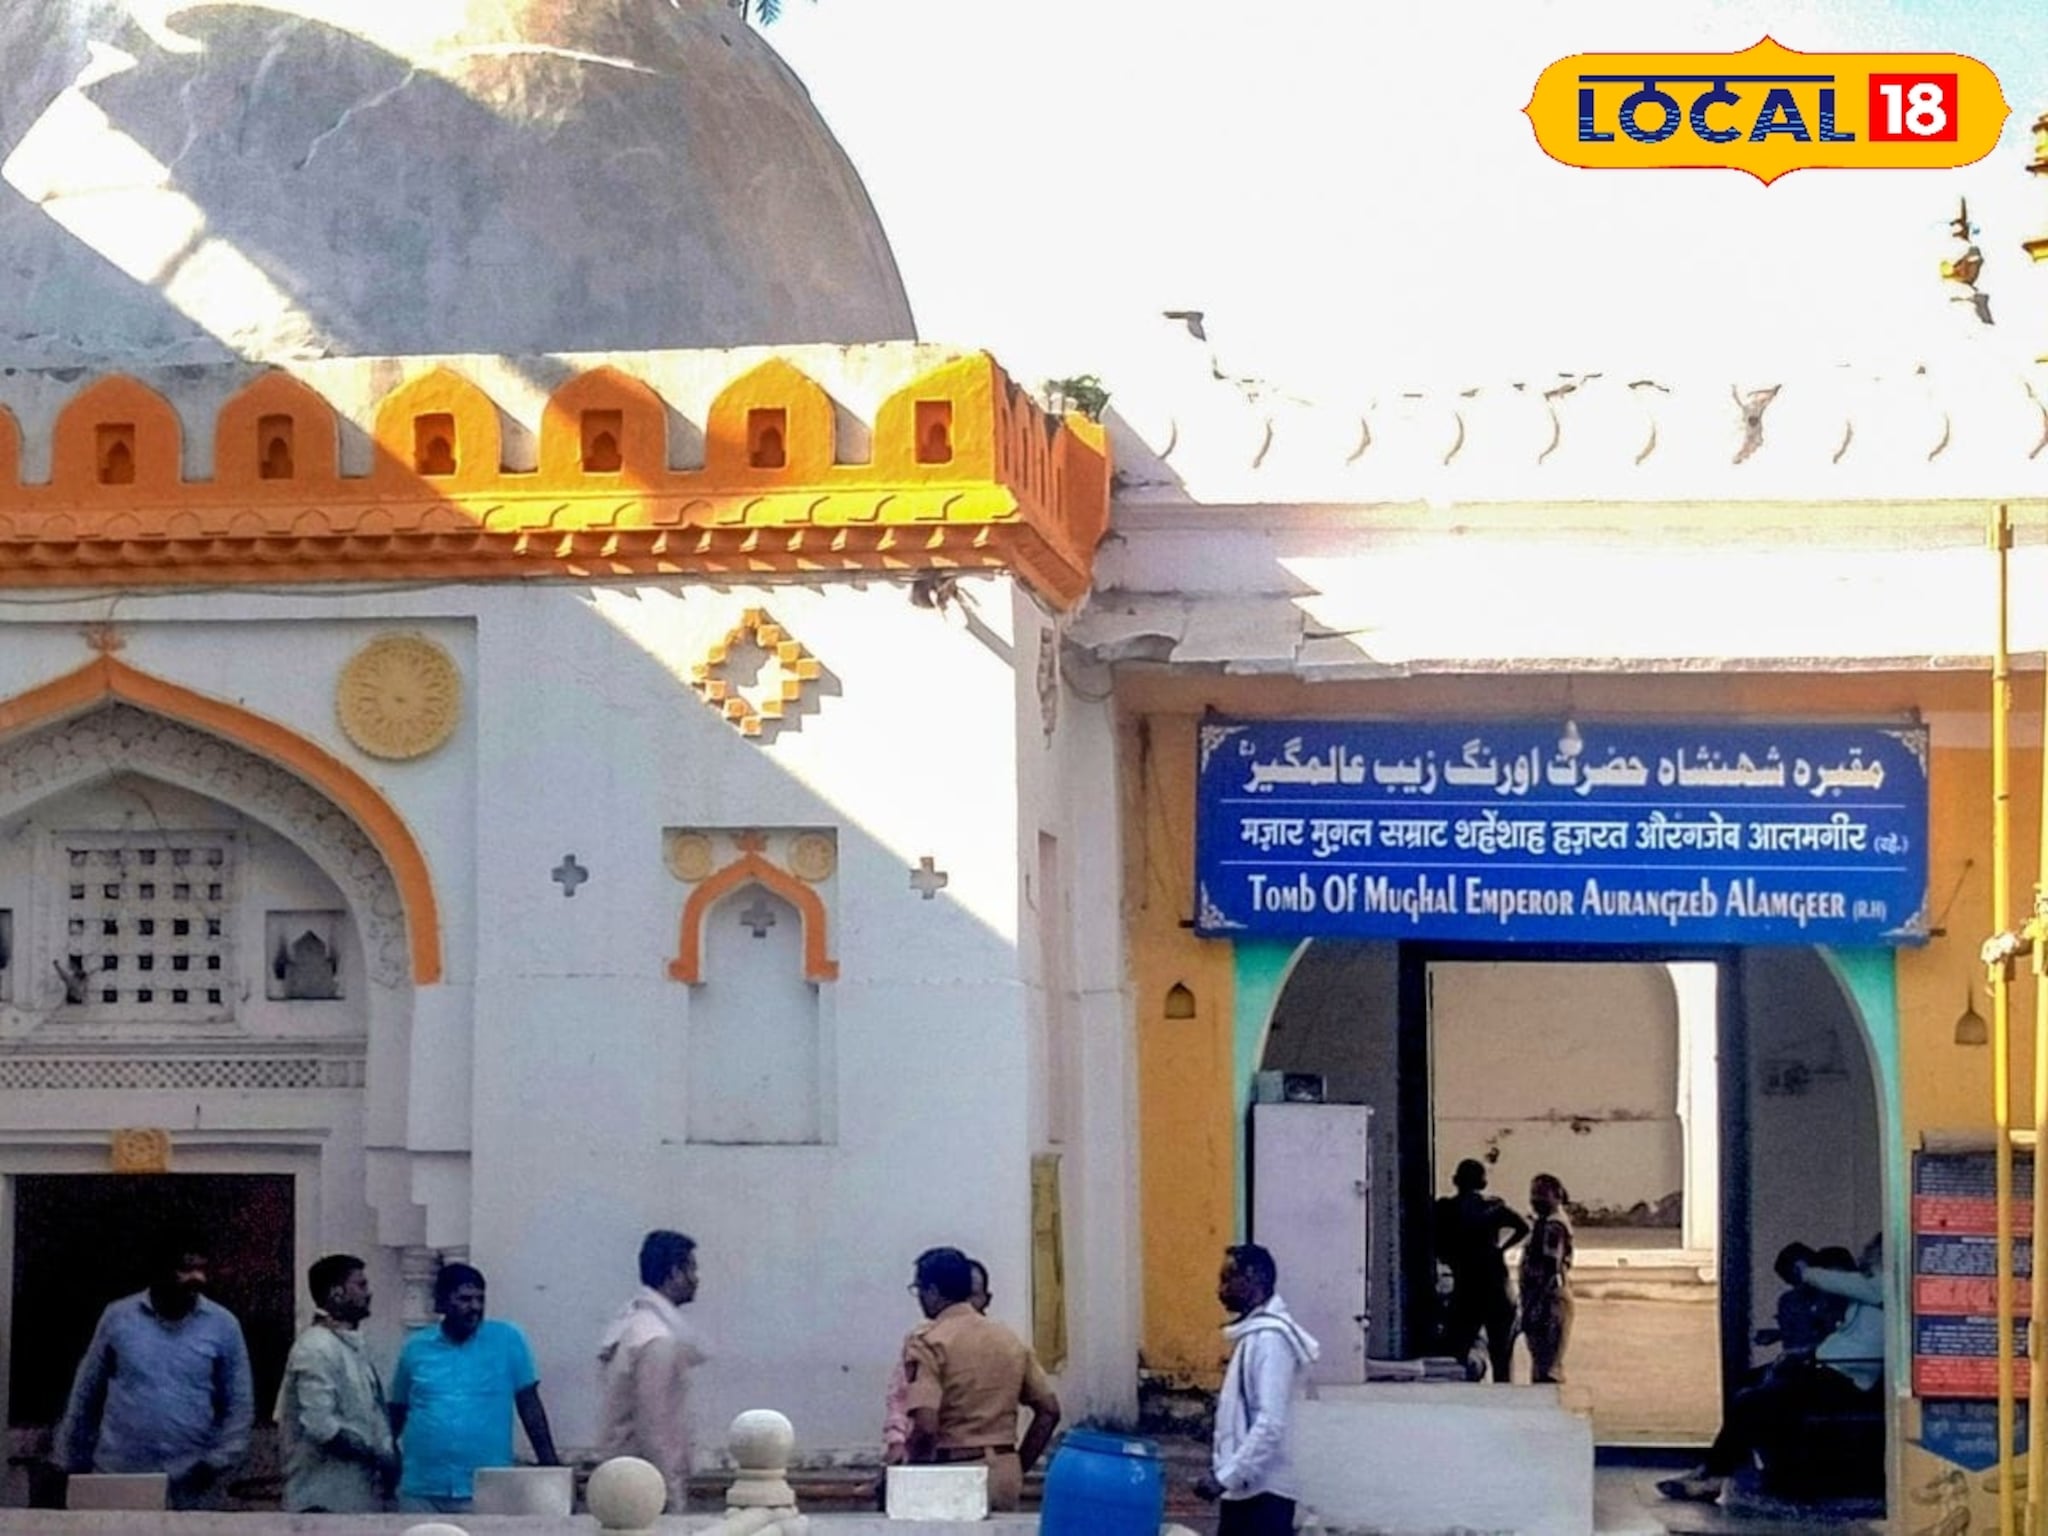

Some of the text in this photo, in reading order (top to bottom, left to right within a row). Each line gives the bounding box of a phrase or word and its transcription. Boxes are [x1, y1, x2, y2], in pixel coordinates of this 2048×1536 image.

[1374, 751, 1437, 794] زیب
[1444, 739, 1540, 795] اورنگ
[1241, 819, 1304, 851] मज़ार
[1379, 820, 1448, 848] सम्राट
[1455, 809, 1546, 854] शहेंशाह
[1552, 821, 1629, 854] हज़रत
[1748, 812, 1867, 851] आलमगीर
